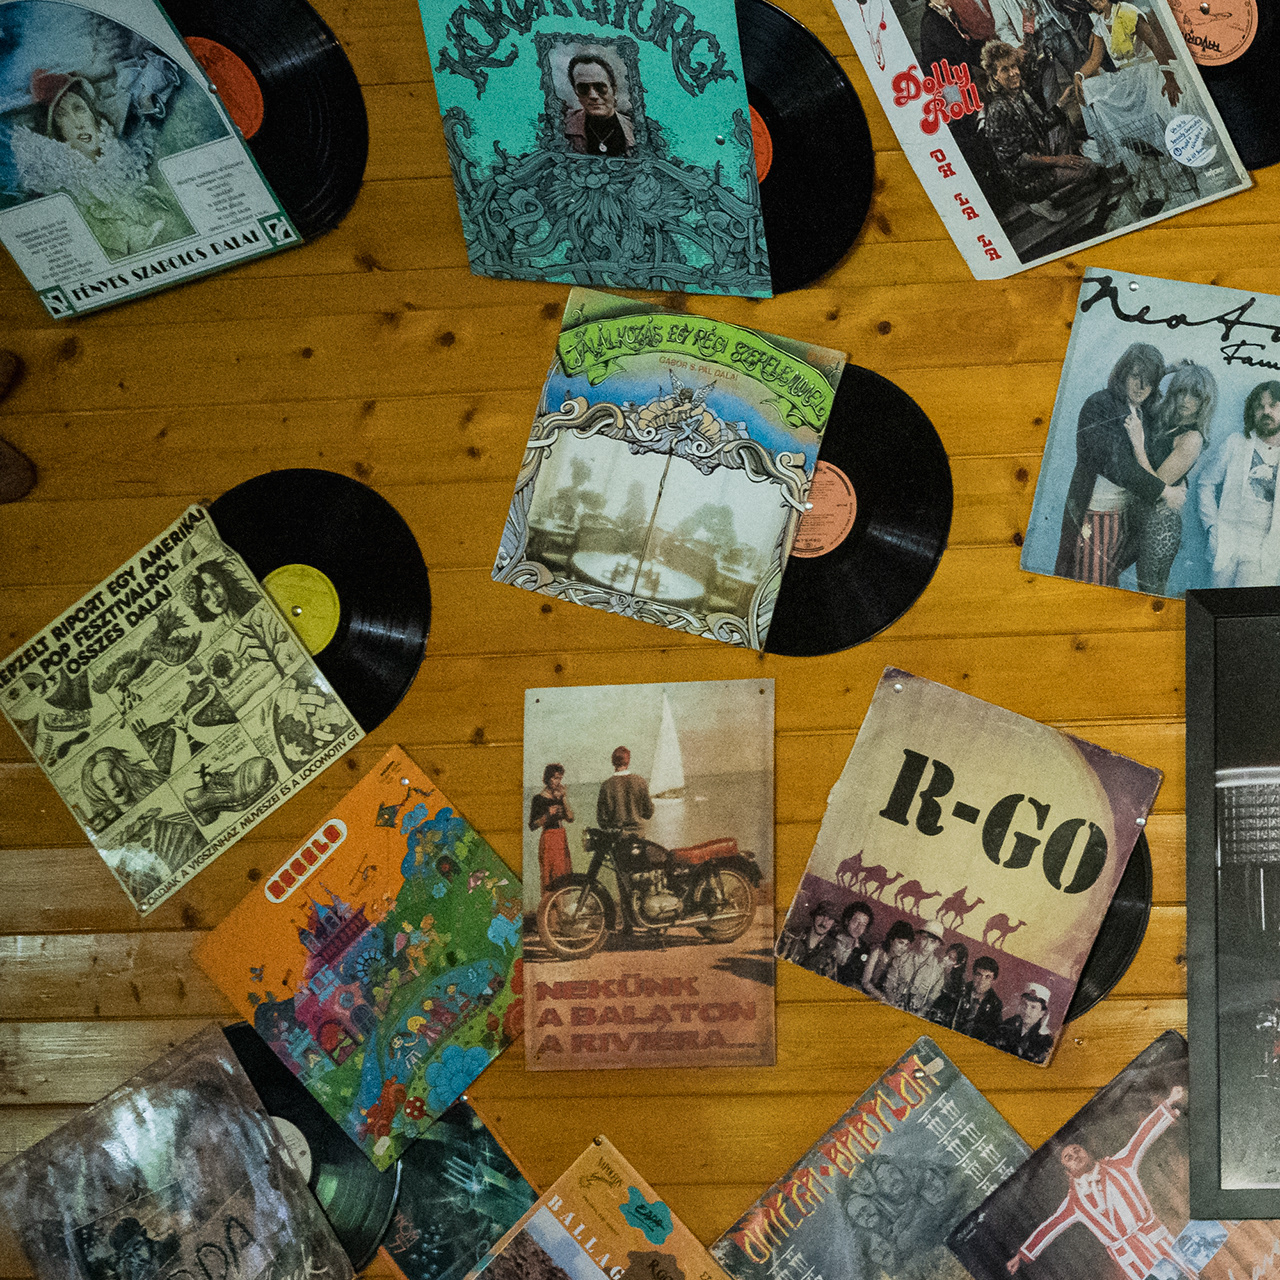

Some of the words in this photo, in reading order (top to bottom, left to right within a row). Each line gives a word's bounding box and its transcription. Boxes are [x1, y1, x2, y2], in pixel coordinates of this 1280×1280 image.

[892, 58, 970, 108] Dolly
[920, 82, 983, 135] Roll
[930, 148, 956, 179] OH
[954, 192, 979, 221] LA
[131, 247, 207, 283] SZABOLCS
[210, 230, 260, 255] DALAI
[977, 233, 1002, 262] LA
[669, 324, 693, 344] EGY
[51, 591, 106, 642] RIPORT
[106, 565, 137, 597] EGY
[140, 508, 207, 573] AMERIKAI
[124, 584, 172, 628] DALAI
[39, 643, 71, 674] POP
[300, 741, 347, 782] LOCOMOTIV
[347, 729, 360, 743] GT
[878, 748, 1109, 896] R-GO
[534, 974, 700, 1002] NEKÜNK
[536, 1009, 564, 1029] A
[570, 1001, 757, 1028] BALATON
[535, 1035, 563, 1055] A
[547, 1195, 625, 1280] BALLAG
